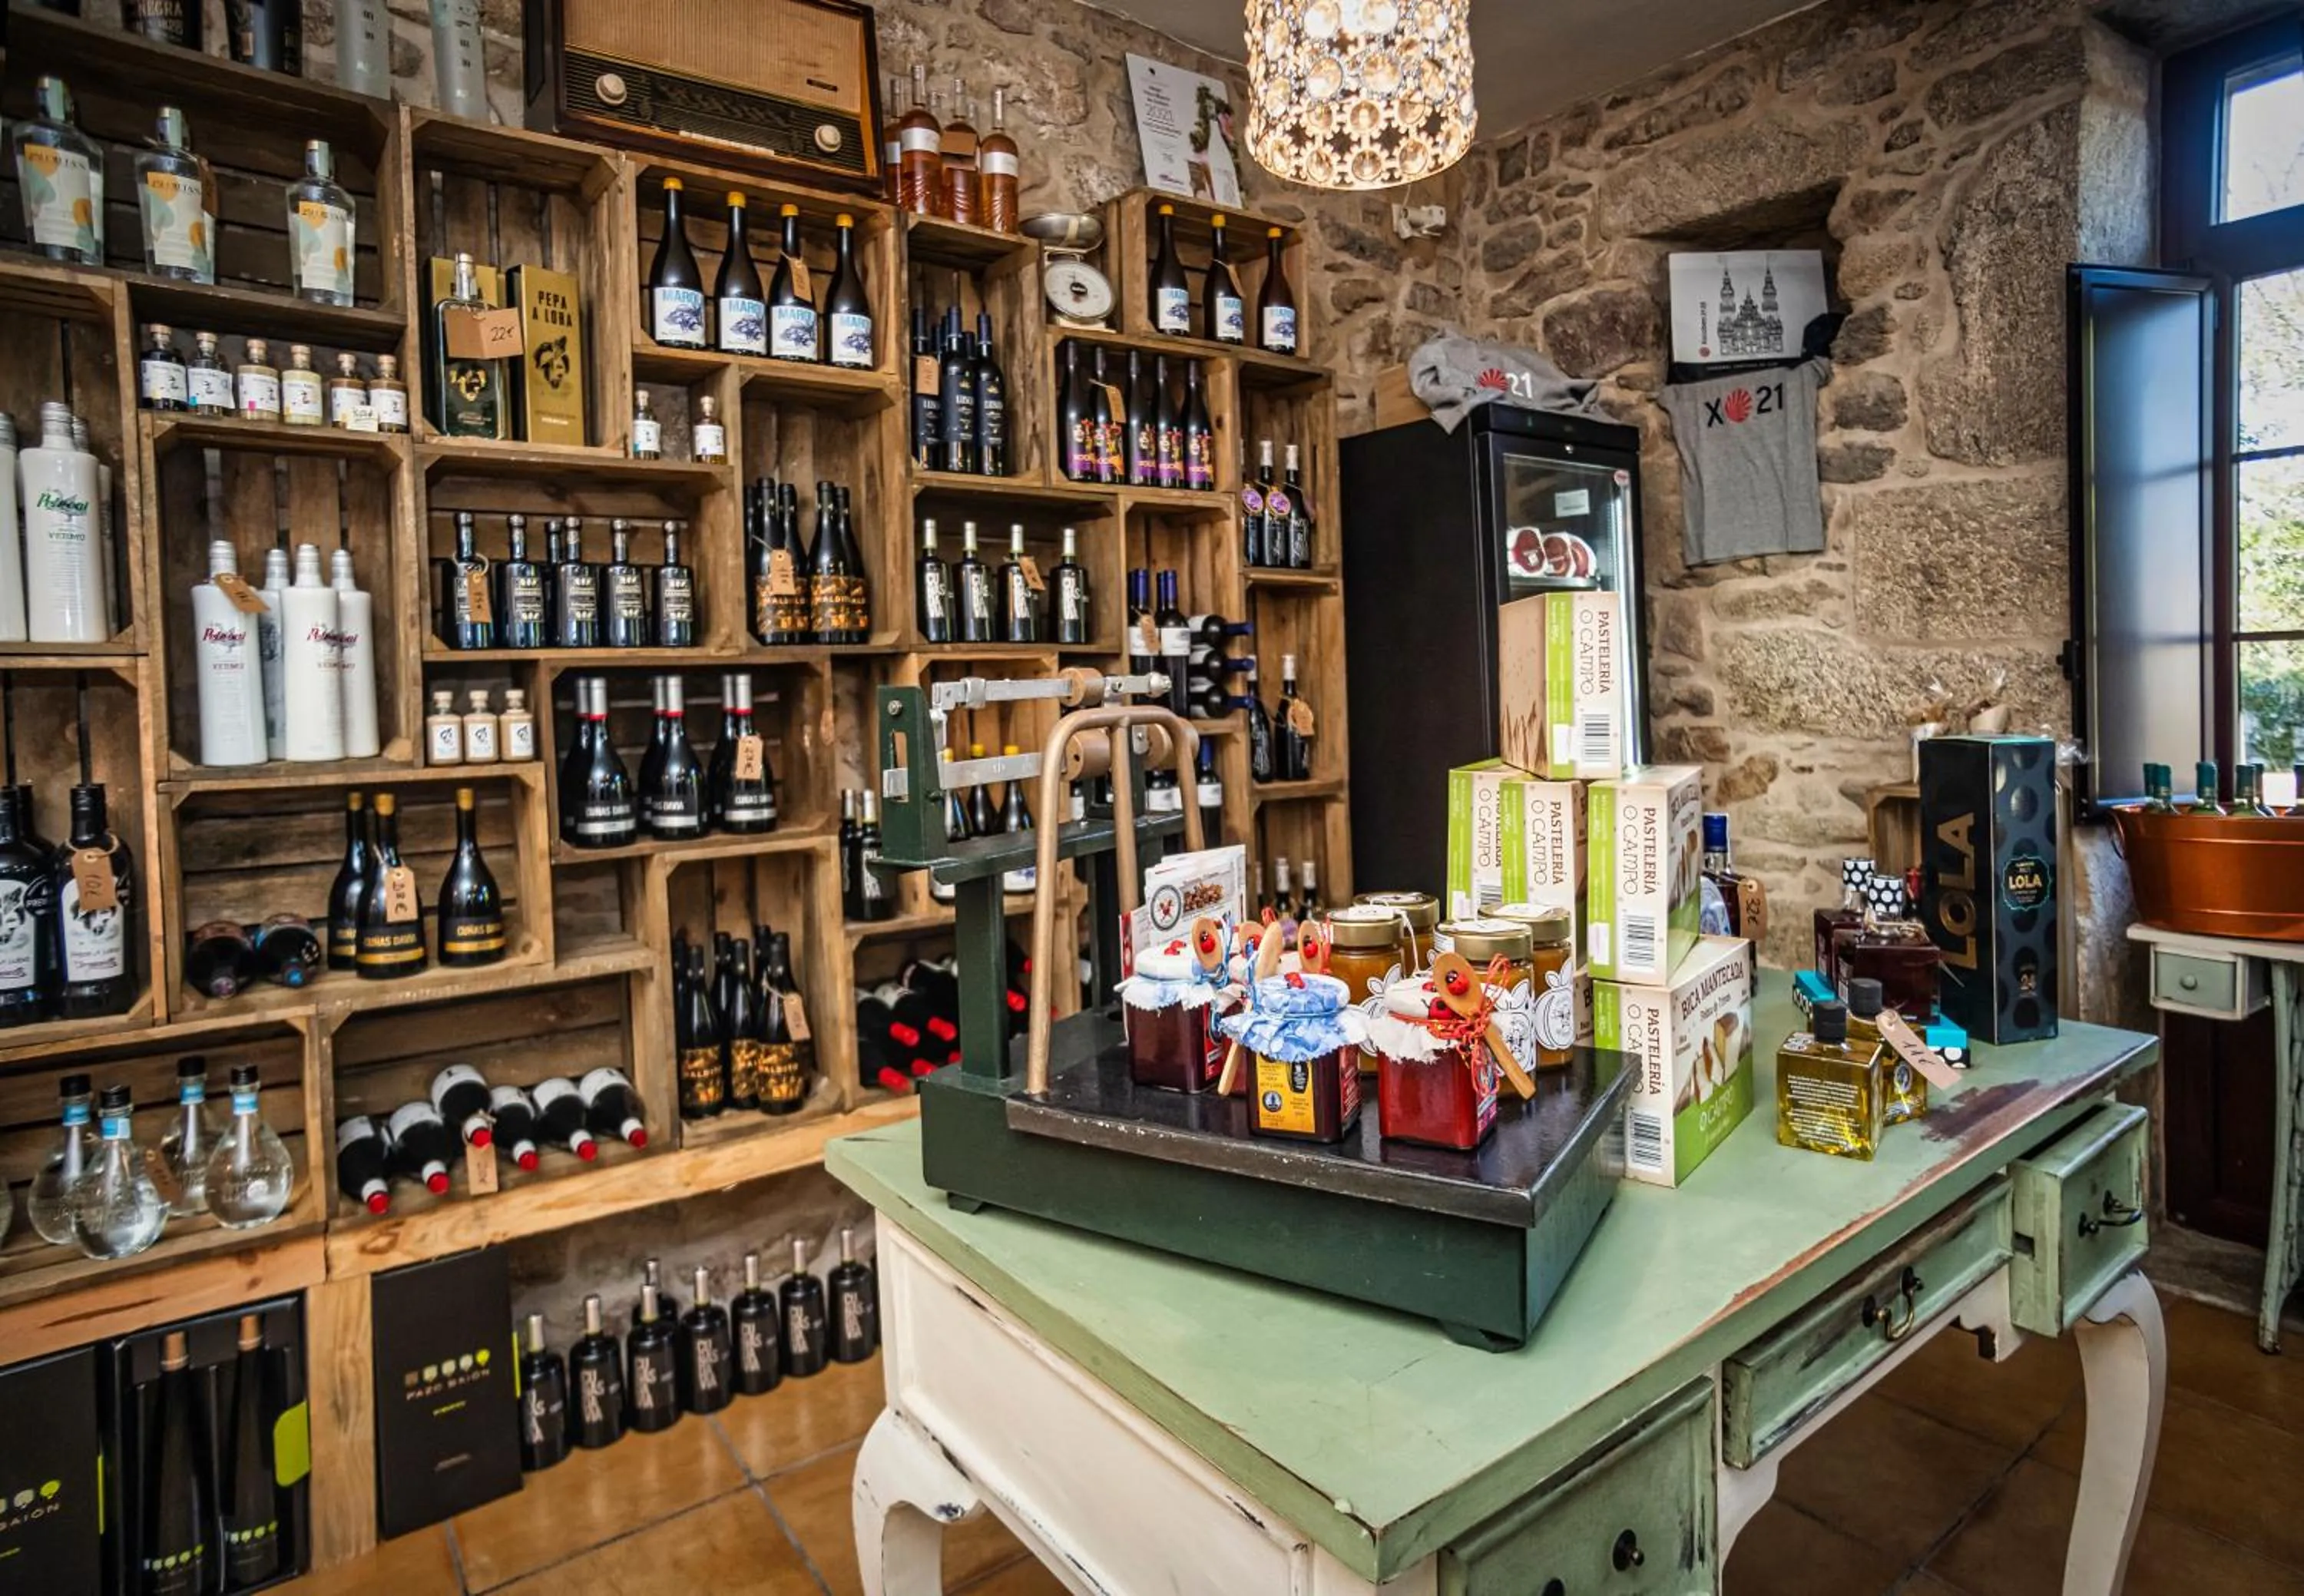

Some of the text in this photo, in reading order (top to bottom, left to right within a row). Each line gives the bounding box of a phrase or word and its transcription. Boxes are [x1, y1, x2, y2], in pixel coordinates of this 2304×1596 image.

[532, 307, 573, 327] A LOBA
[538, 290, 567, 310] PEPA
[1507, 372, 1533, 399] 21
[1704, 382, 1784, 428] X 21
[1598, 611, 1614, 694] PASTELERÍA
[1478, 805, 1491, 867] CAMPO
[1532, 818, 1548, 886] CAMPO
[1550, 801, 1567, 885] PASTELERÍA
[1623, 823, 1638, 895] CAMPO
[1644, 807, 1660, 896] PASTELERÍA
[1938, 812, 1978, 970] LOLA
[2008, 873, 2043, 891] LOLA
[1680, 988, 1701, 1022] BICA
[1700, 960, 1745, 999] MANTECADA
[1647, 1007, 1662, 1095] PASTELERÍA
